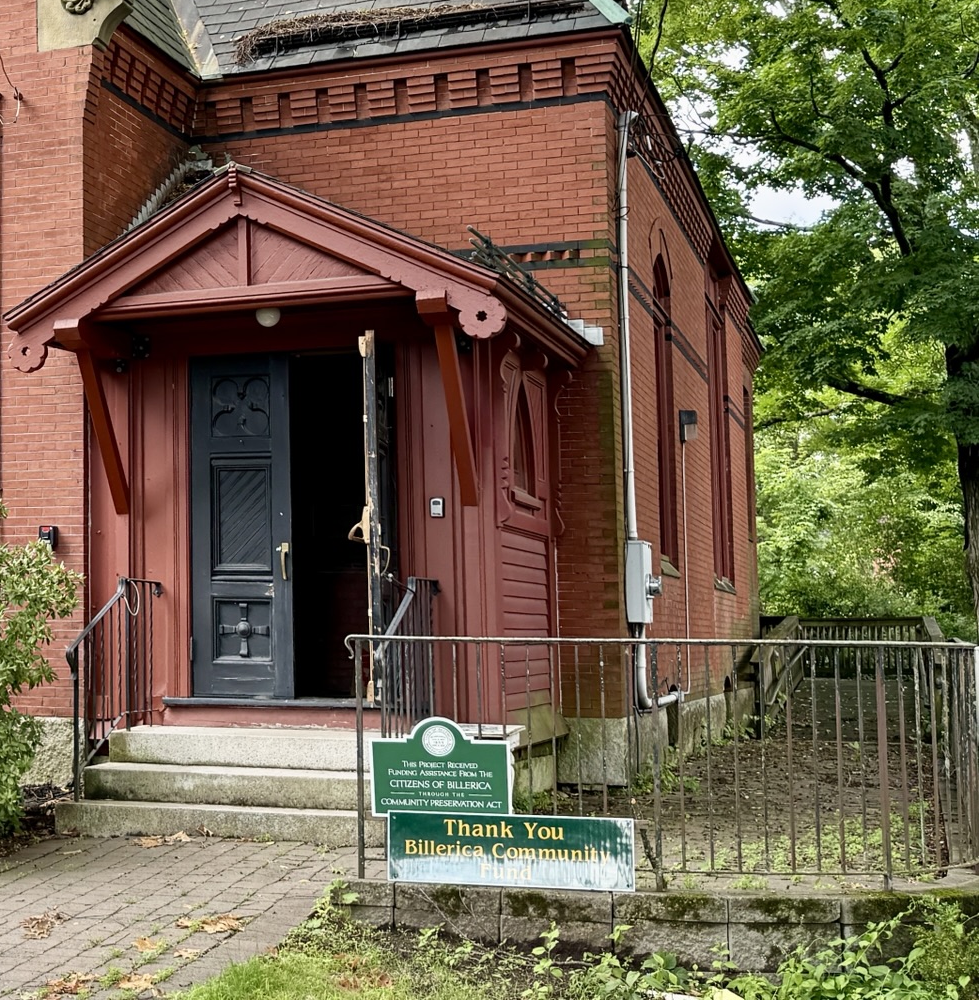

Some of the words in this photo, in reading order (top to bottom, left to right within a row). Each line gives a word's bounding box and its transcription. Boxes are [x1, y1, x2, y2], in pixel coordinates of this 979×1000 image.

[389, 780, 430, 789] CITIZENS
[432, 780, 444, 789] OF
[447, 781, 492, 790] BILLERICA
[380, 798, 430, 806] COMMUNITY
[430, 799, 484, 808] PRESERVATION
[486, 801, 502, 809] ACT
[443, 818, 514, 838] Thank
[523, 822, 565, 840] You
[404, 838, 484, 858] Billerica
[492, 843, 610, 865] Community
[480, 863, 532, 880] Fund
